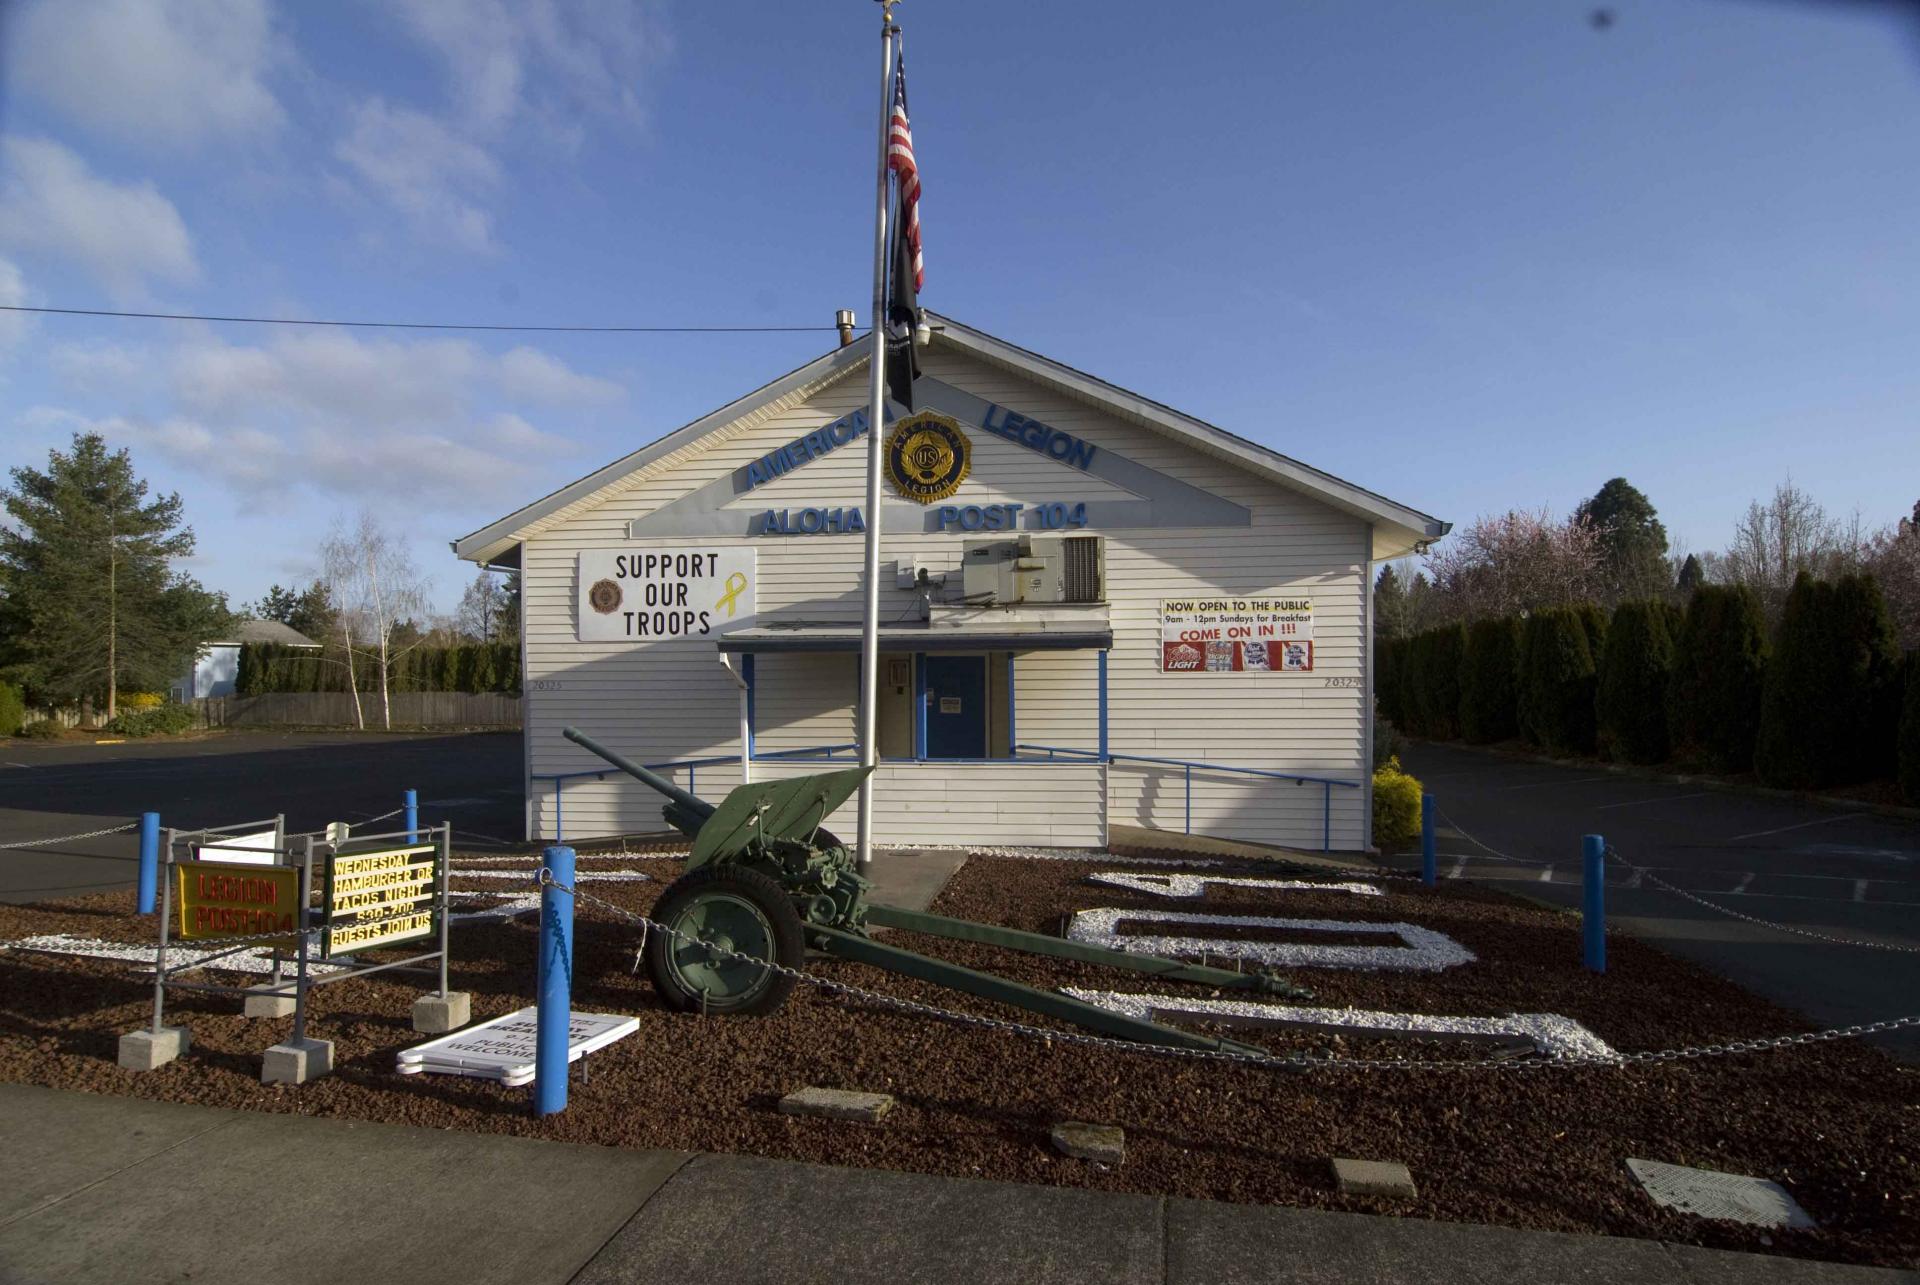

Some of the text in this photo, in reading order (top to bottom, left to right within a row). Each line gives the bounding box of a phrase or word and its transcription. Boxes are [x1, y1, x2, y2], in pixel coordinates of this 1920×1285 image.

[981, 404, 1097, 470] LEGION
[918, 450, 937, 465] US
[904, 479, 951, 495] LEGION
[763, 502, 1088, 534] ALOHA POST 104
[616, 553, 718, 579] SUPPORT
[645, 583, 688, 607] OUR
[1166, 600, 1310, 612] NOW OPEN TO THE PUBLIC
[623, 611, 710, 636] TROOPS
[1165, 615, 1183, 623] 9am
[1194, 614, 1216, 625] 12pm
[1220, 613, 1254, 624] Sundays
[1257, 613, 1269, 622] for
[1272, 613, 1311, 622] Breakfast
[1180, 623, 1296, 642] COME ON IN !!!
[1168, 661, 1200, 669] LIGHT
[335, 853, 411, 876] WEDNESDAY
[198, 873, 277, 906] LEGION
[334, 866, 433, 894] HAMBURGER OR
[334, 884, 424, 912] TACOS NIGHT
[331, 915, 431, 946] GUESTS JOIN US
[473, 1039, 537, 1051] PUBLIC
